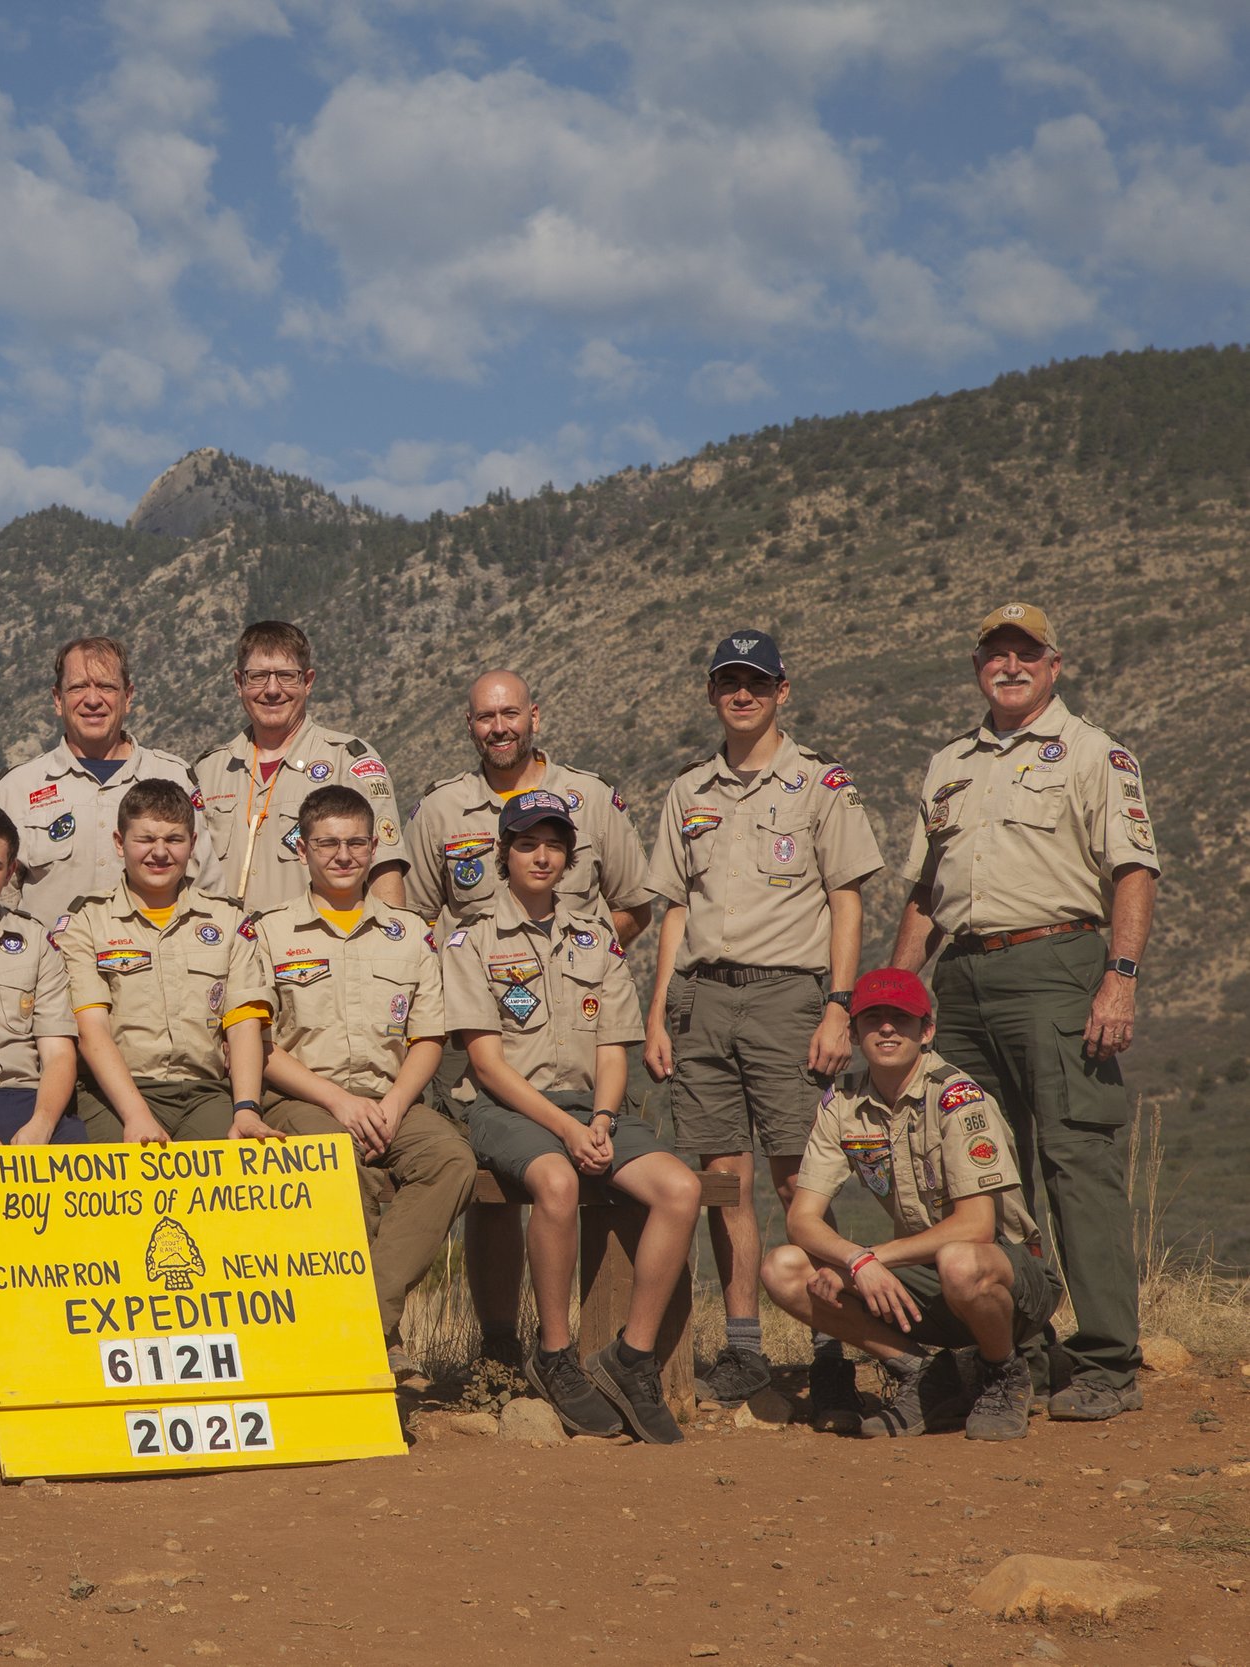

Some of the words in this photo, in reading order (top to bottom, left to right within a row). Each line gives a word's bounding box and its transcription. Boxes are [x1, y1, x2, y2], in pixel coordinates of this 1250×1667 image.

[370, 782, 390, 796] 366
[519, 791, 565, 813] USA
[117, 938, 134, 946] BSA
[295, 948, 312, 956] BSA
[963, 1113, 986, 1132] 366
[140, 1149, 225, 1182] SCOUT
[238, 1142, 339, 1176] RANCH
[2, 1192, 50, 1235] BOY
[64, 1189, 143, 1218] SCOUTS
[187, 1181, 312, 1215] AMERICA
[156, 1230, 186, 1243] PHILMONT
[222, 1253, 279, 1280] NEW
[287, 1250, 366, 1277] MEXICO
[65, 1288, 296, 1334] EXPEDITION
[107, 1343, 238, 1384] 612H
[133, 1411, 268, 1454] 2022
